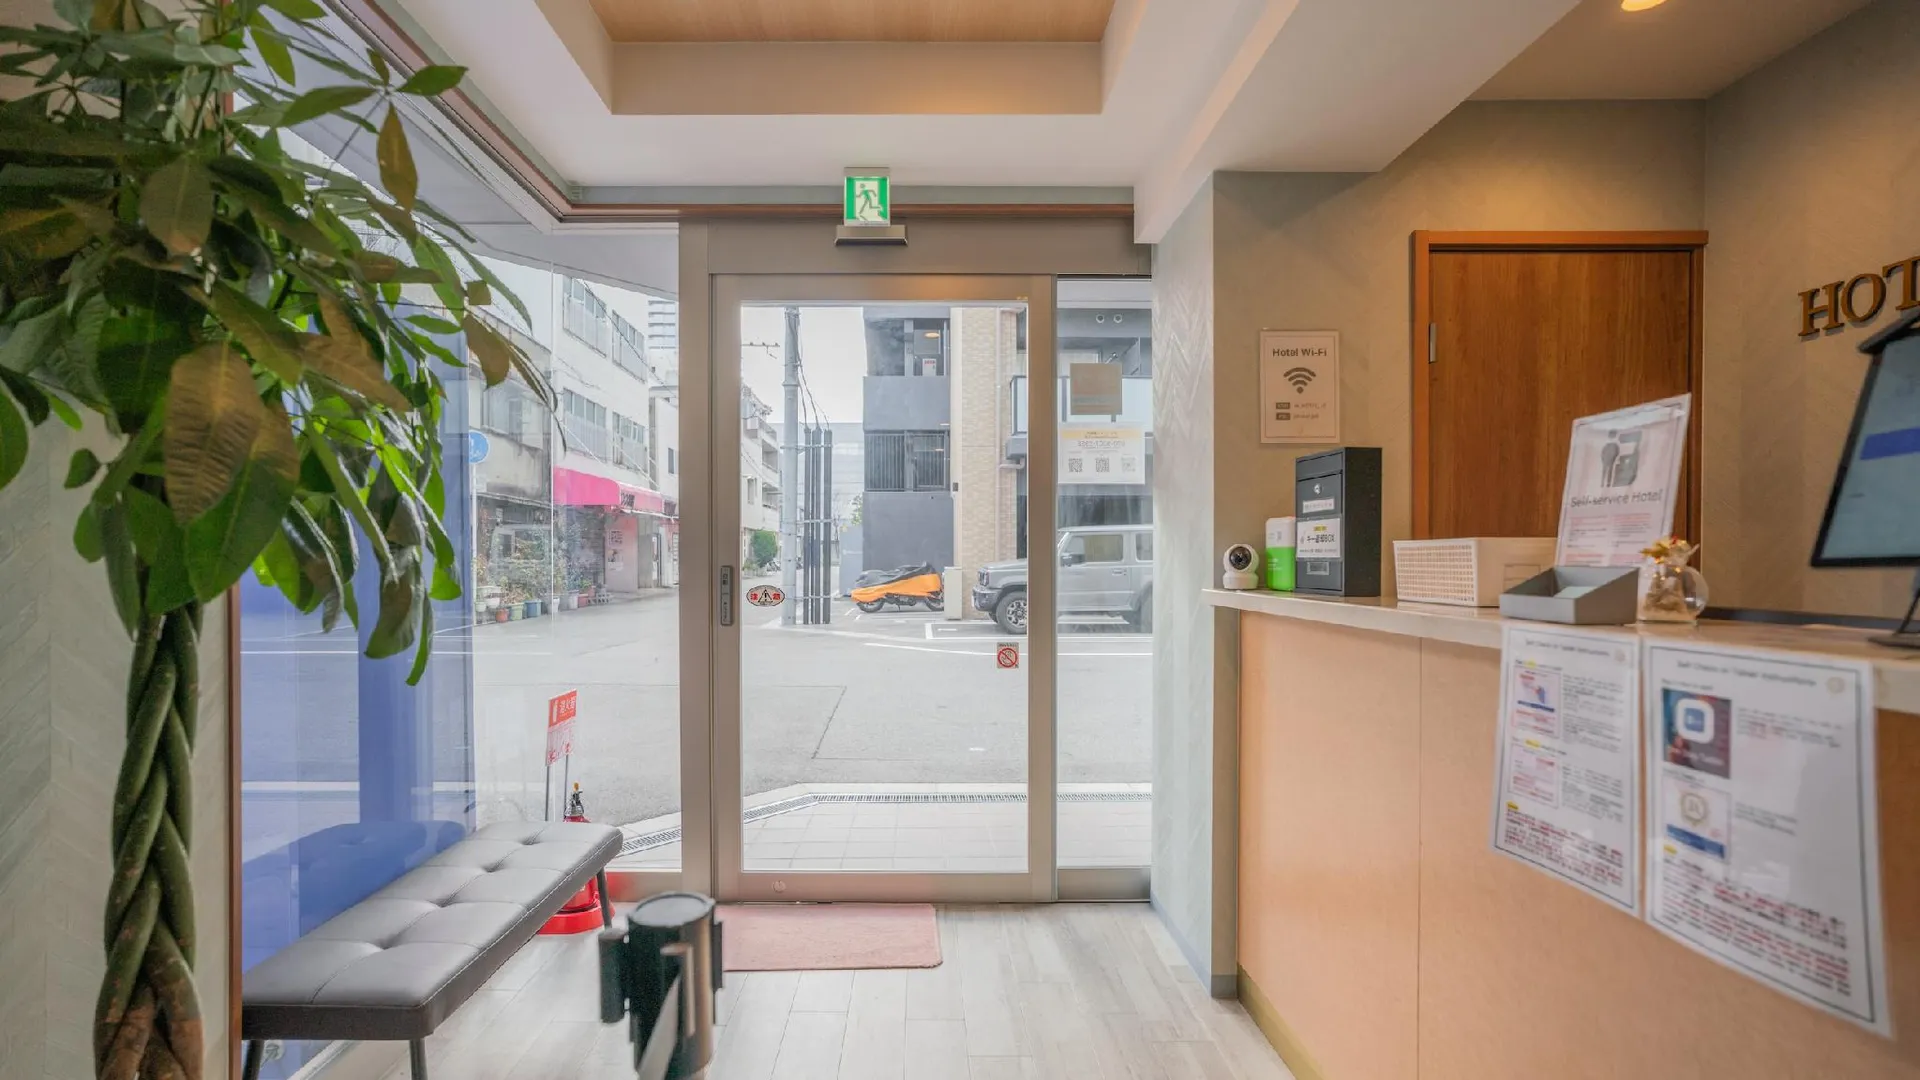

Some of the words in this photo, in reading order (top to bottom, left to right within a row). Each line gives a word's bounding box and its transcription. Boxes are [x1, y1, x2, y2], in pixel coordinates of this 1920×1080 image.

[1798, 256, 1920, 336] HOT
[1273, 348, 1298, 357] Hotel
[1302, 348, 1327, 357] Wi-Fi
[1631, 488, 1663, 503] Hotel
